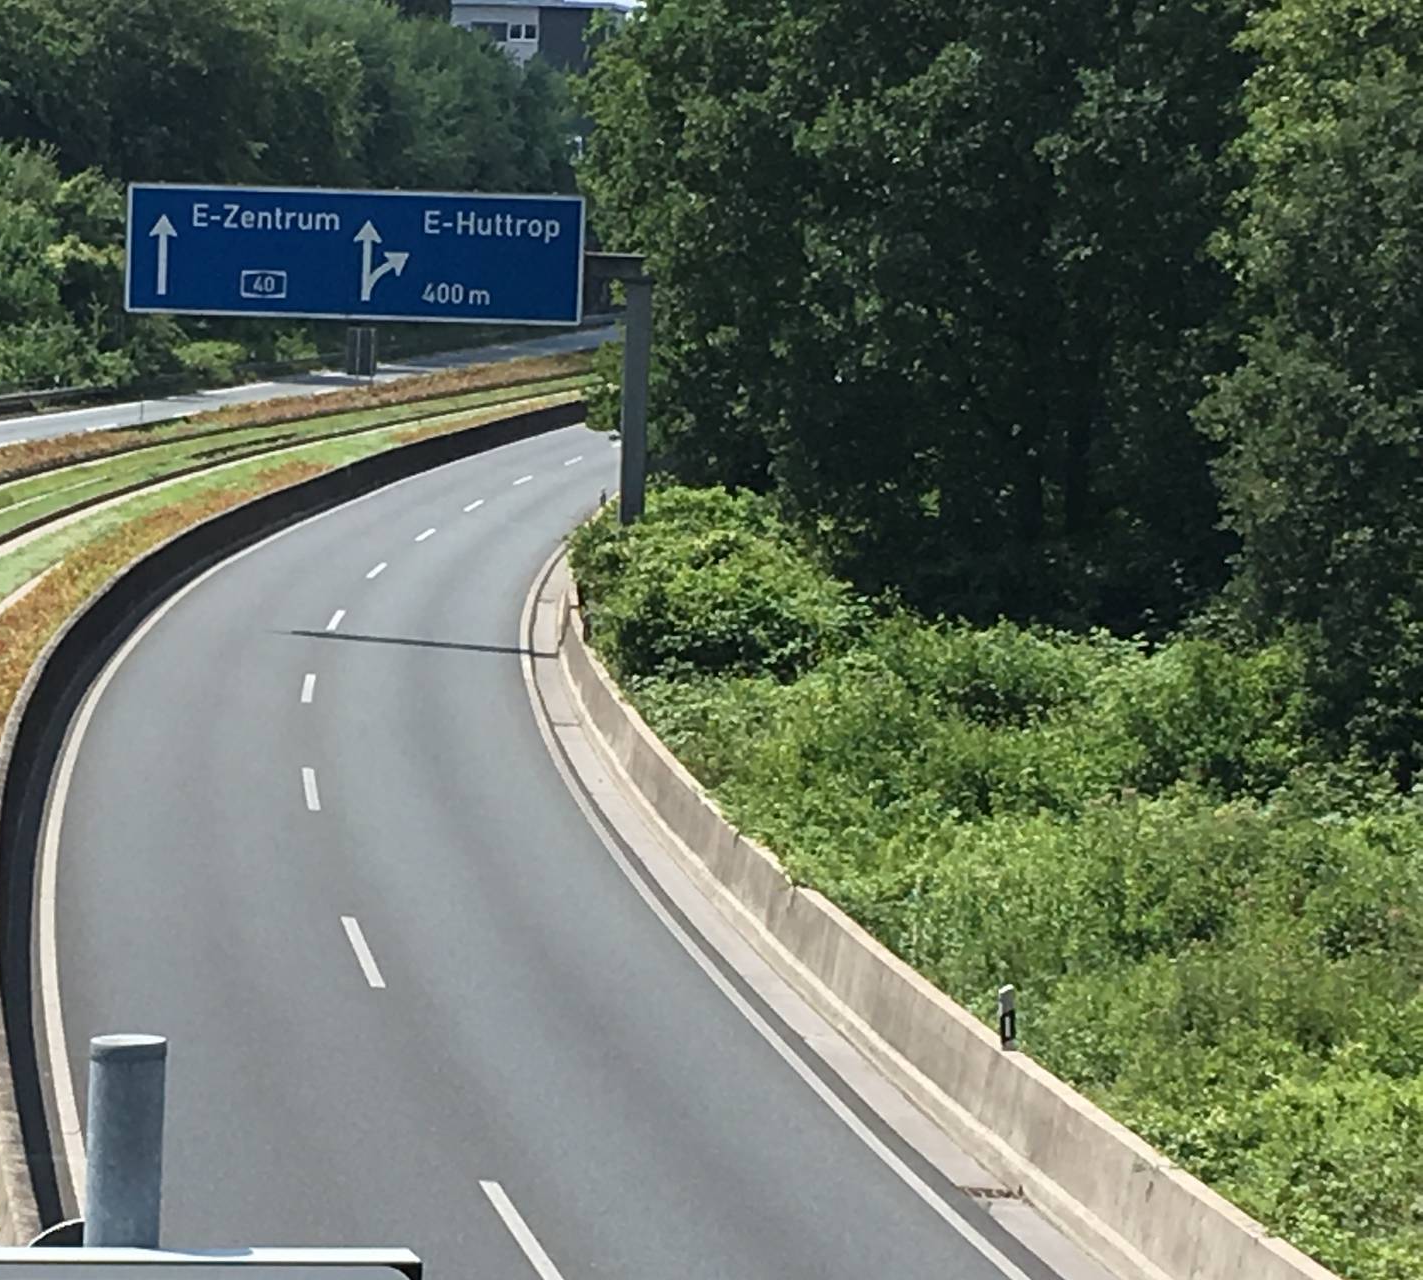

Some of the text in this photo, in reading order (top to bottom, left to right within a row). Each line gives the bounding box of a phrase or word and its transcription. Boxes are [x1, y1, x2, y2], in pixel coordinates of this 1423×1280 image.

[192, 203, 340, 231] E-Zentrum
[424, 210, 560, 243] E-Huttrop
[252, 276, 275, 293] 40
[422, 282, 490, 305] 400 m
